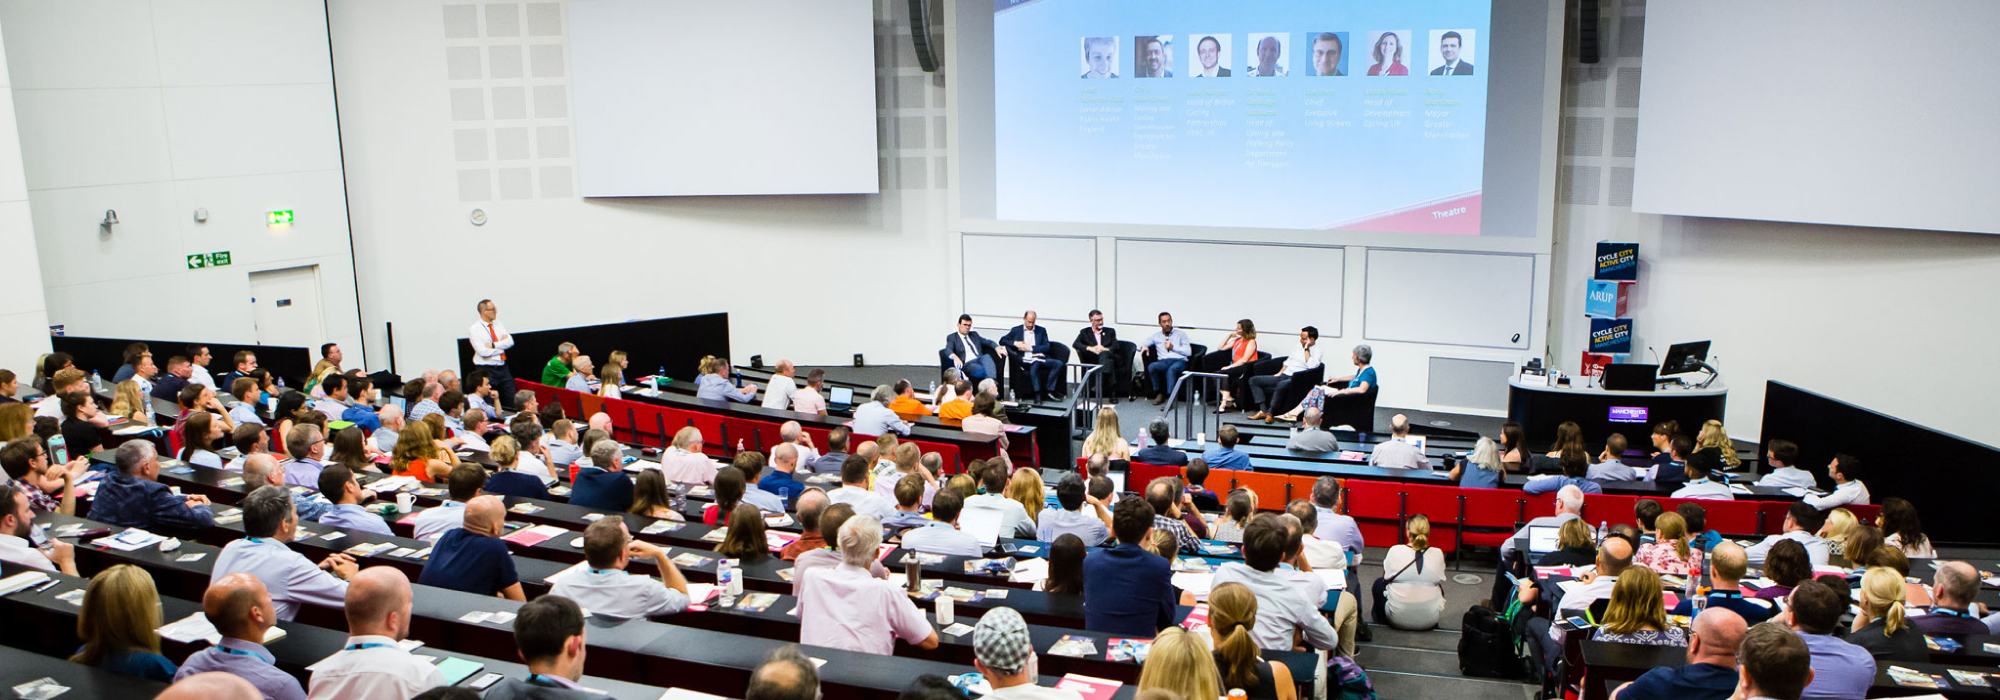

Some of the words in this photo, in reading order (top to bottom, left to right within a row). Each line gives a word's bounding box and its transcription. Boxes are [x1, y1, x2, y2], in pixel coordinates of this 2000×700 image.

[1432, 206, 1467, 220] Theatre
[1598, 252, 1618, 262] CYCLE
[1619, 249, 1633, 257] CITY
[1600, 259, 1619, 268] ACTIVE
[1620, 255, 1634, 263] CITY
[1590, 290, 1614, 303] ARUP
[1593, 327, 1613, 338] CYCLE
[1613, 324, 1627, 332] CITY
[1595, 334, 1614, 343] ACTIVE
[1614, 330, 1628, 338] CITY
